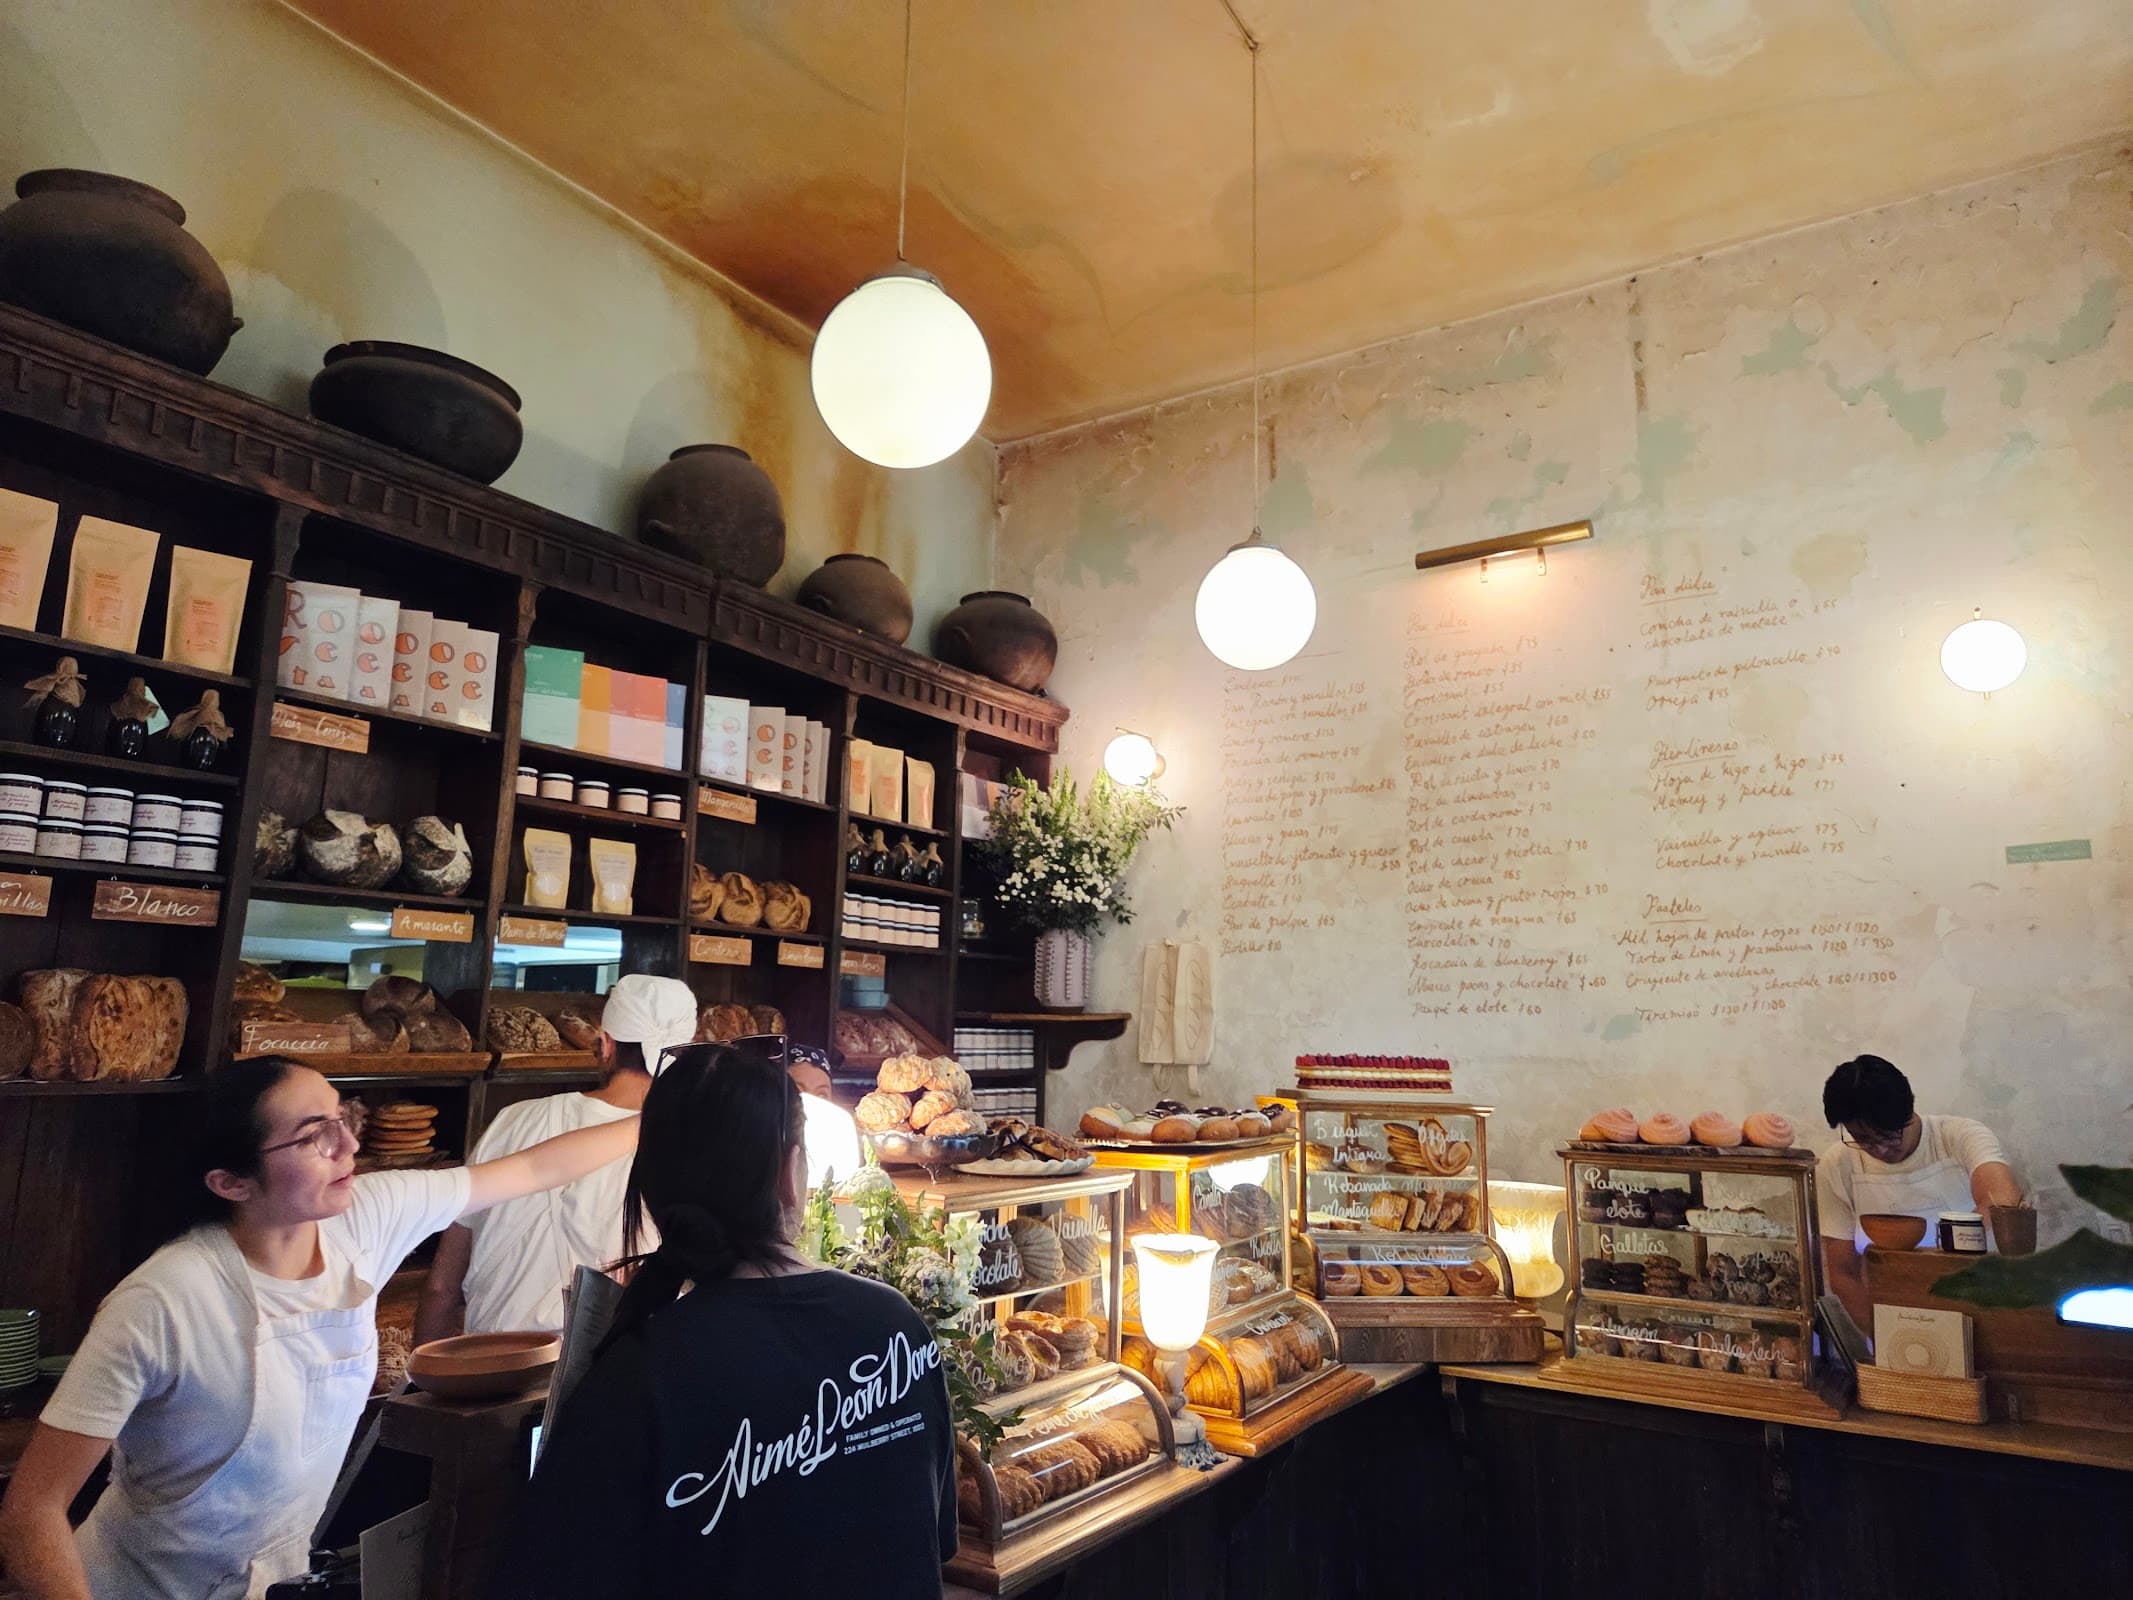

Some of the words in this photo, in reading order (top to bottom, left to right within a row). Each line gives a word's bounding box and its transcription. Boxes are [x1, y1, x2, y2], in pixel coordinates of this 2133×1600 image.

[110, 885, 201, 916] Blanco
[1642, 893, 1703, 920] Pasteles
[399, 915, 466, 935] Amaranto
[1606, 1199, 1648, 1219] elote
[1048, 1204, 1108, 1242] Vainilla
[1600, 1231, 1669, 1255] Galletas
[969, 1246, 1022, 1287] ocolate
[665, 1414, 815, 1536] Aimé
[799, 1374, 888, 1477] Leon
[849, 1331, 941, 1405] Dore
[846, 1430, 869, 1443] FAMILY
